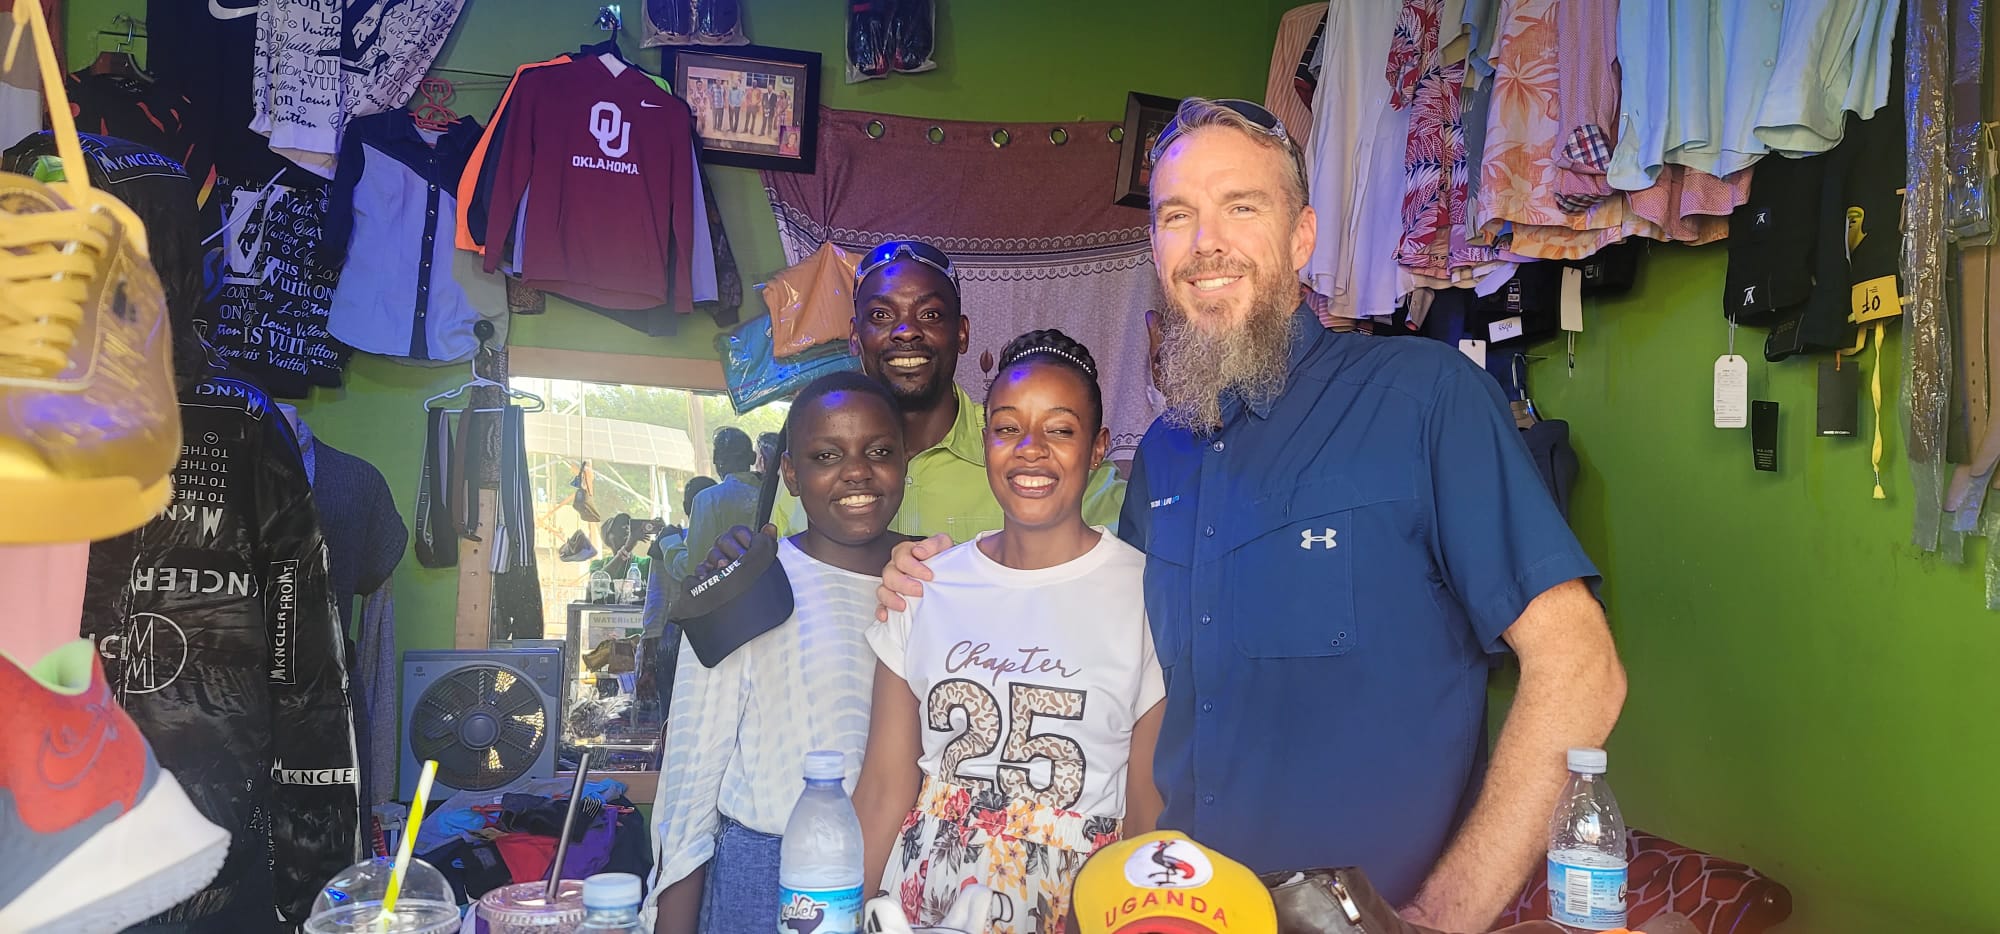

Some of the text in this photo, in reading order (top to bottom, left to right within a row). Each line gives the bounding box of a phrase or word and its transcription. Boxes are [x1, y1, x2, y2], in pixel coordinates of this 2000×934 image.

[572, 155, 640, 175] OKLAHOMA
[182, 445, 230, 458] TO THE
[180, 460, 229, 473] TO THE
[180, 474, 205, 485] THE
[209, 477, 227, 488] TO
[178, 489, 205, 501] THE
[208, 492, 225, 504] TO
[945, 639, 1082, 687] Chapter
[927, 678, 1088, 811] 25
[1105, 889, 1229, 929] UGANDA
